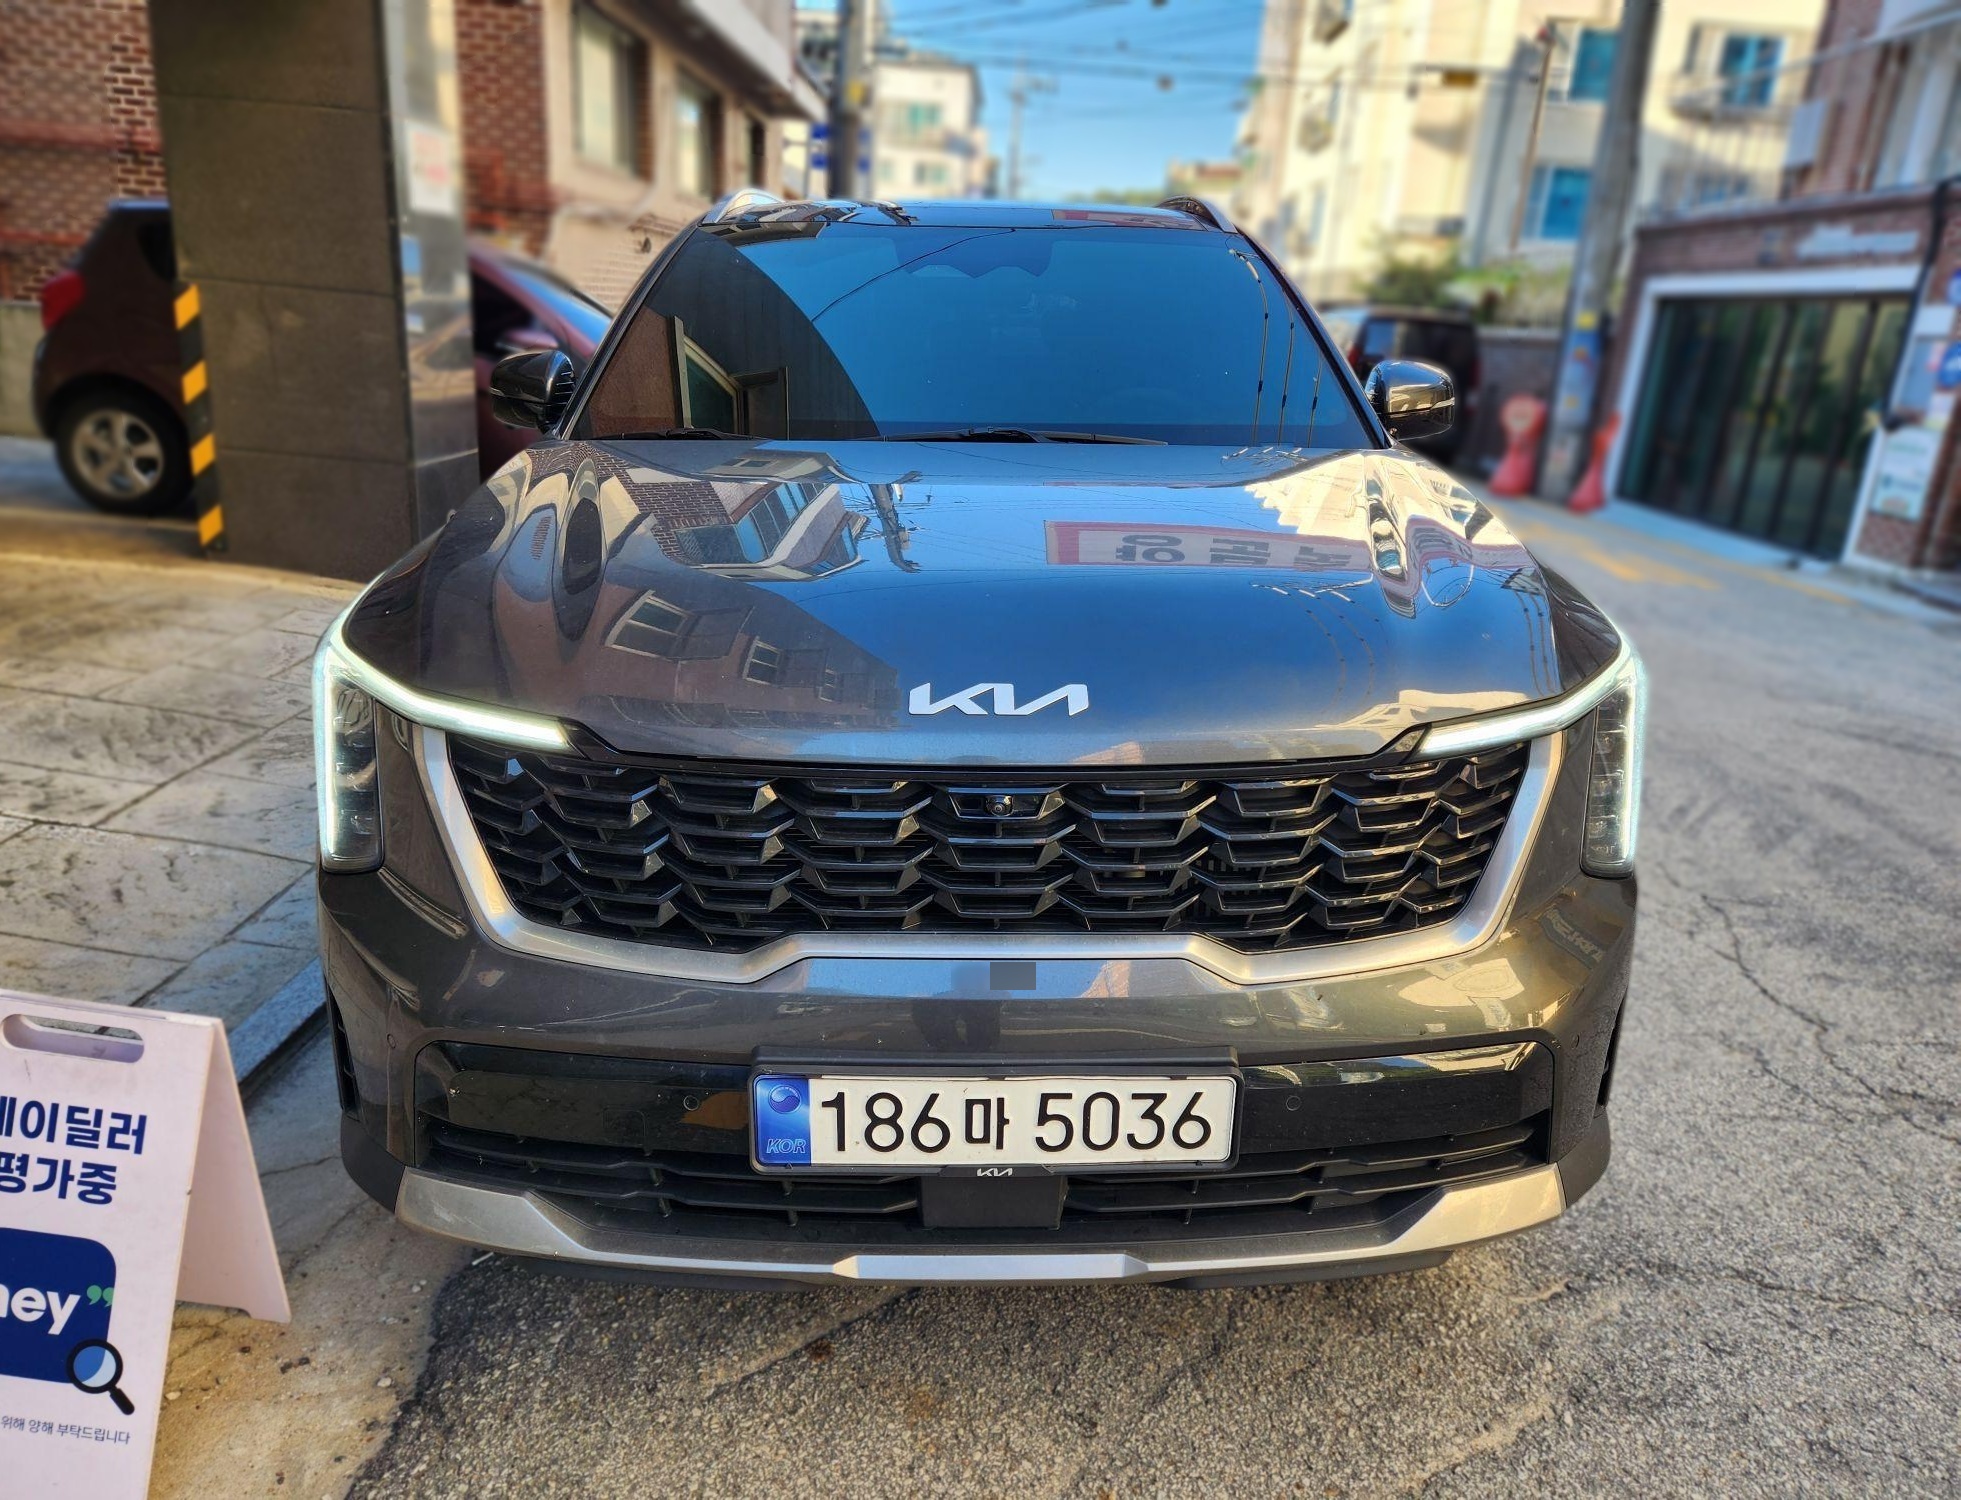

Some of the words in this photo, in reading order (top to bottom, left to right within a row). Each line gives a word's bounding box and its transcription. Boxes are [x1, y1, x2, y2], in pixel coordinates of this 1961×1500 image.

[909, 682, 1089, 716] KIA
[821, 1091, 1010, 1154] 186마
[1035, 1090, 1212, 1154] 5036
[766, 1138, 806, 1154] KOR
[976, 1167, 1013, 1177] KIA
[0, 1415, 25, 1431] 위해
[28, 1418, 54, 1435] 양해
[57, 1422, 131, 1445] 부탁드립니다
